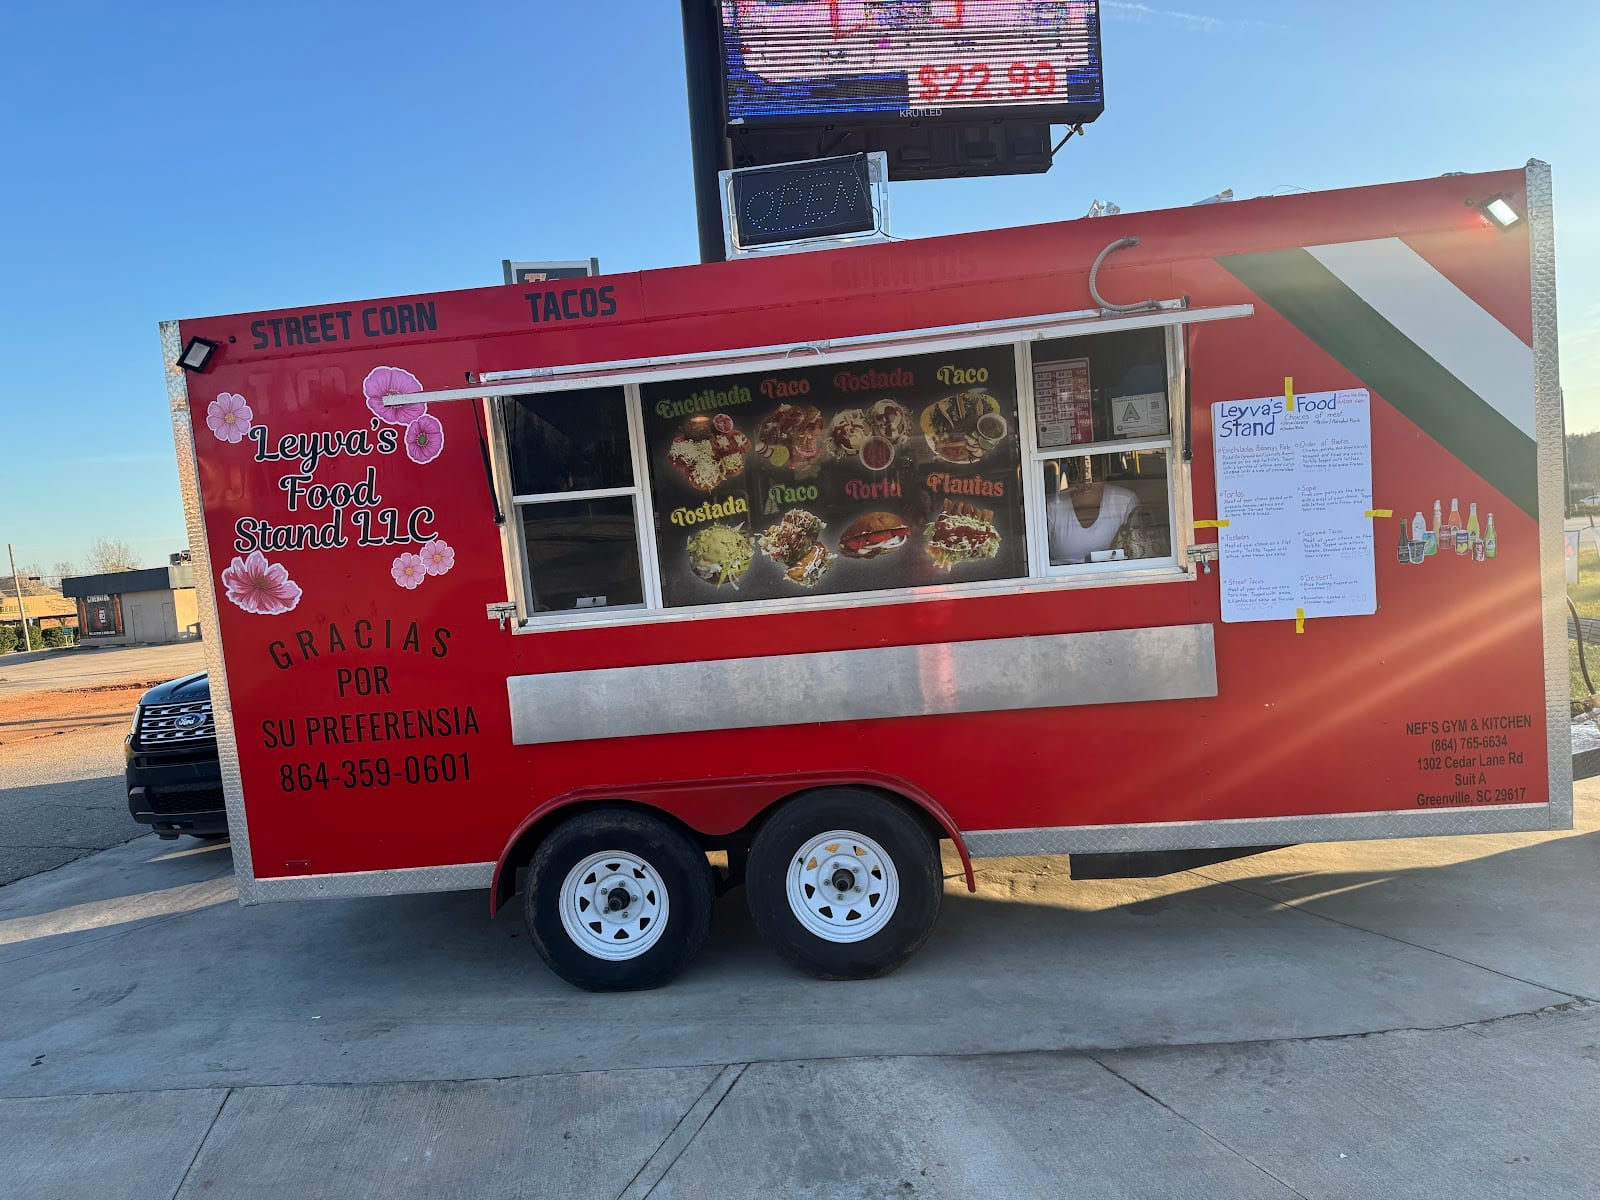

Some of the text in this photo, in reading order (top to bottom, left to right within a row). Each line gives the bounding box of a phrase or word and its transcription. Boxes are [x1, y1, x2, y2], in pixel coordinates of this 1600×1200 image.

[917, 61, 1056, 103] $22.99
[899, 108, 943, 119] KRUTLED
[746, 179, 860, 223] OPEN
[525, 286, 617, 323] TACOS
[250, 301, 438, 350] STREET CORN
[833, 368, 914, 392] Tostada
[936, 364, 988, 385] Taco
[760, 378, 810, 399] Taco
[656, 385, 752, 419] Enchilada
[1122, 402, 1141, 421] A
[1221, 398, 1283, 421] Leyva's
[1296, 393, 1337, 413] Food
[1219, 415, 1275, 438] Stand
[1284, 413, 1310, 422] Choices
[1315, 411, 1324, 419] of
[249, 418, 398, 473] Leyva's
[279, 466, 381, 511] Food
[768, 484, 818, 504] Taco
[927, 472, 1004, 497] Flautas
[670, 495, 748, 527] Tostada
[235, 506, 438, 553] Stand LLC
[1305, 573, 1332, 582] Dessert
[269, 619, 452, 670] GRACIAS
[337, 666, 391, 697] POR
[262, 706, 480, 749] SU PREFERENSIA
[1406, 714, 1532, 735] NEF'S GYM & KITCHEN
[1431, 735, 1508, 754] (864) 765-6634
[280, 752, 471, 793] 864-359-0601
[1417, 752, 1524, 770] 1302 Cedar Lane Rd
[1455, 772, 1487, 786] Suit A
[1416, 788, 1527, 807] Greenville, SC 29617
